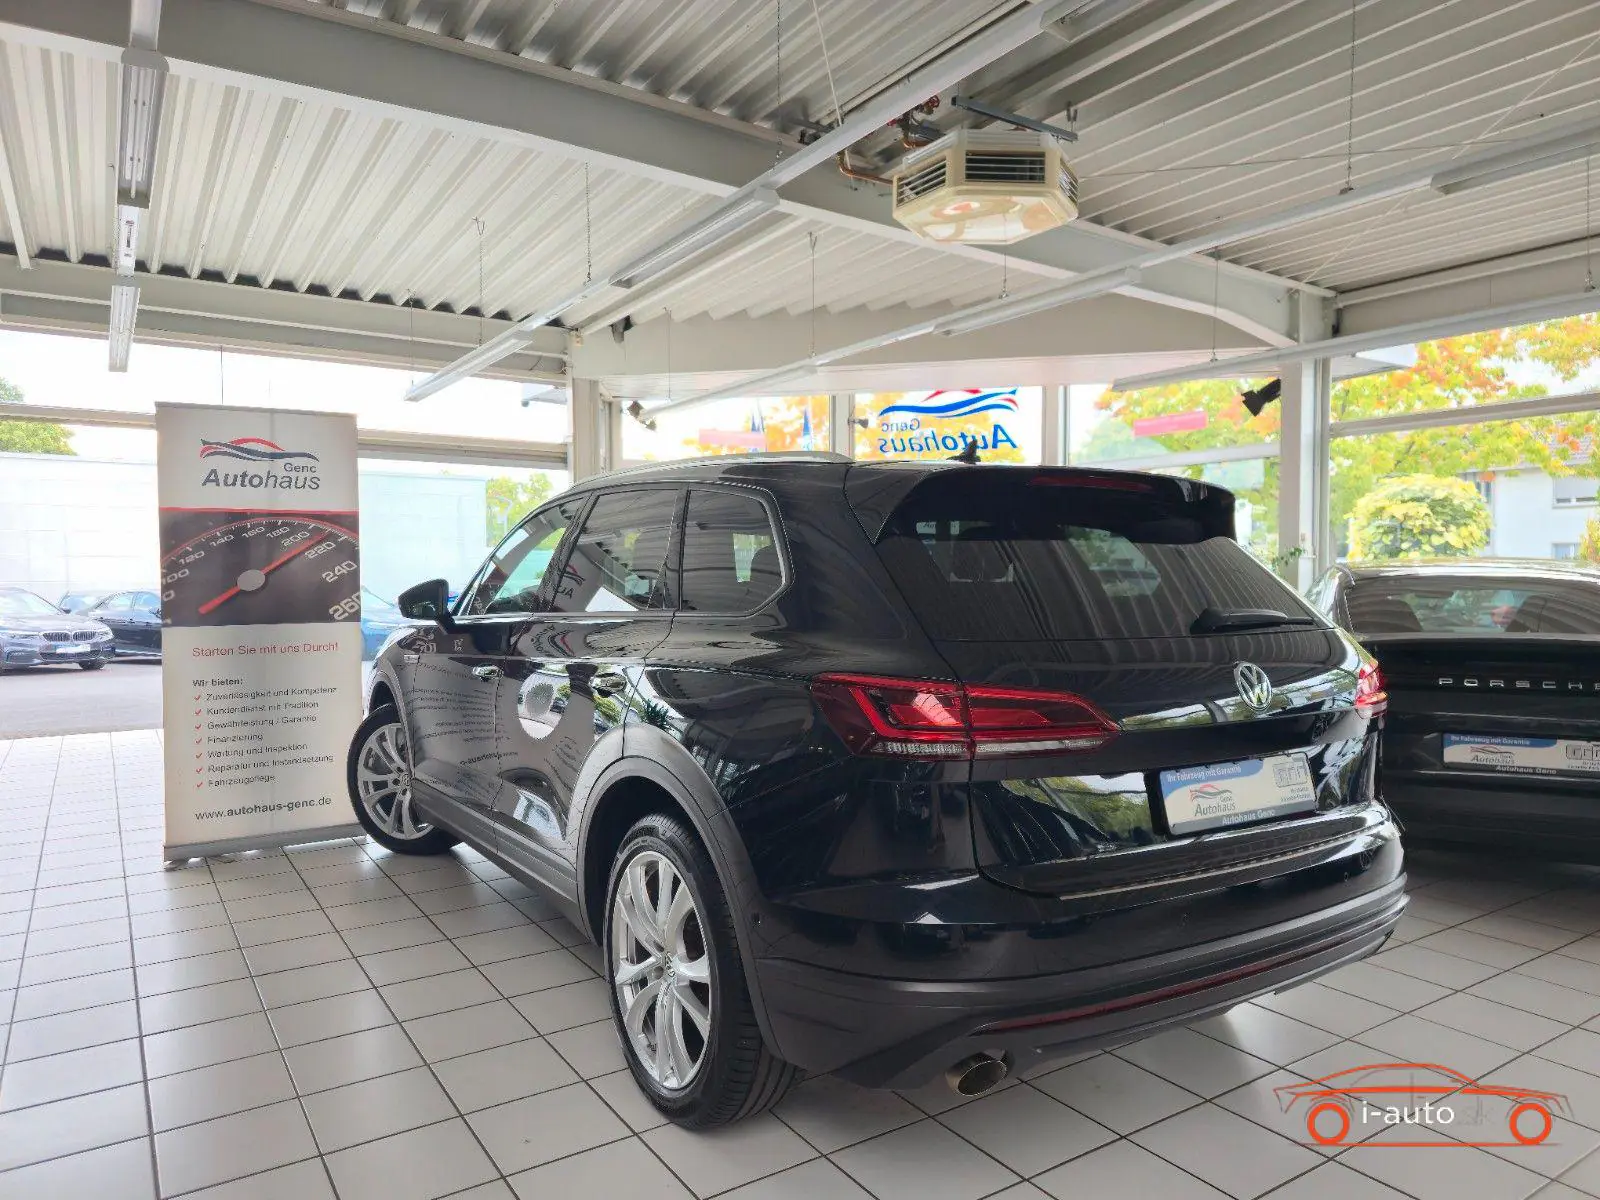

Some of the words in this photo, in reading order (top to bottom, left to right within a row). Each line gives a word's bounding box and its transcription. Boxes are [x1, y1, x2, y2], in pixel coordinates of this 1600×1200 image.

[283, 462, 317, 473] Genc
[202, 468, 321, 490] Autohaus
[210, 534, 235, 547] 140
[281, 530, 310, 547] 200
[304, 541, 336, 559] 220
[179, 550, 205, 565] 120
[321, 560, 358, 583] 240
[192, 647, 234, 657] Starten
[238, 645, 257, 655] Sie
[259, 644, 277, 654] mit
[280, 644, 300, 654] uns
[192, 679, 209, 687] Wir
[273, 688, 289, 697] und
[207, 704, 267, 715] Kundendienst
[207, 733, 264, 745] Finanzierung
[207, 747, 244, 759] Wartung
[246, 746, 263, 755] und
[265, 743, 308, 754] Inspektion
[208, 762, 251, 774] Reparatur
[253, 760, 270, 769] und
[1495, 765, 1533, 773] Autohaus
[195, 796, 333, 821] www.autohaus-genc.de
[1194, 802, 1236, 817] Autohaus
[1222, 811, 1256, 826] Autohaus
